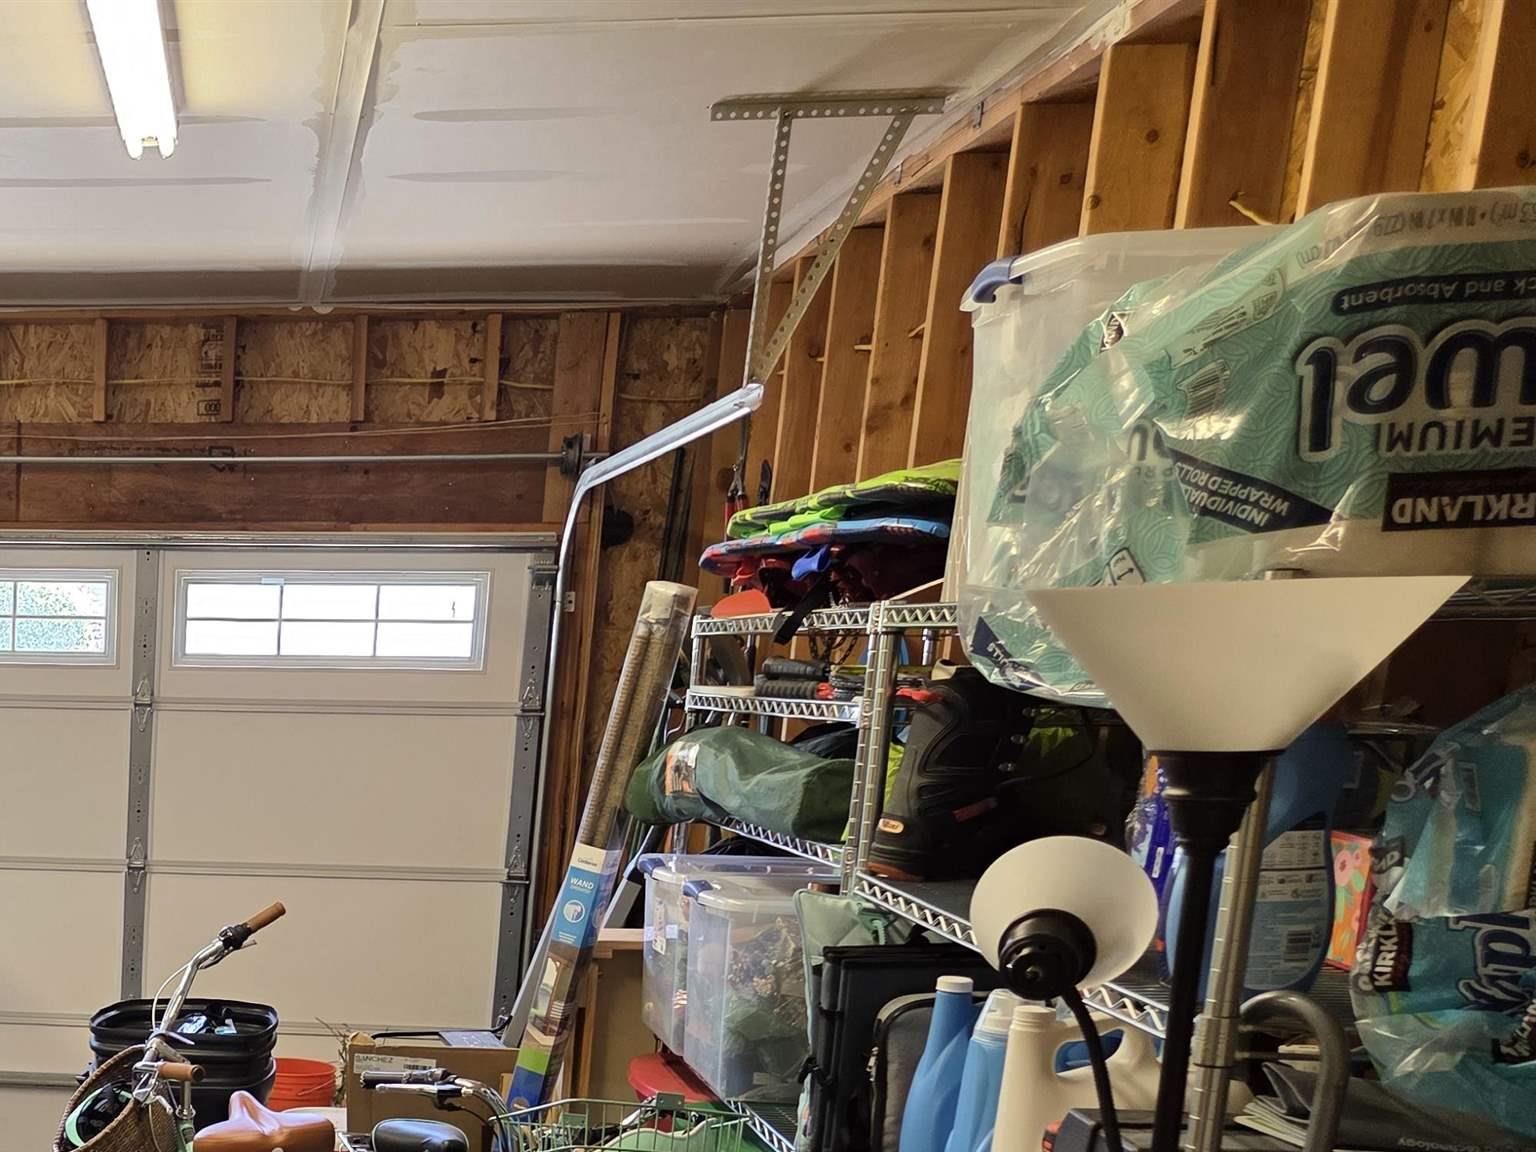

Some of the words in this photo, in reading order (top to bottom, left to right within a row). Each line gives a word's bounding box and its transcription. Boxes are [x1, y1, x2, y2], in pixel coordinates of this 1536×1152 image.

[1341, 280, 1460, 309] Absorbent
[1464, 279, 1506, 299] and
[1174, 462, 1210, 486] ROLLS
[1182, 483, 1270, 528] INDIVIDUAL
[1207, 477, 1291, 517] WRAPPED
